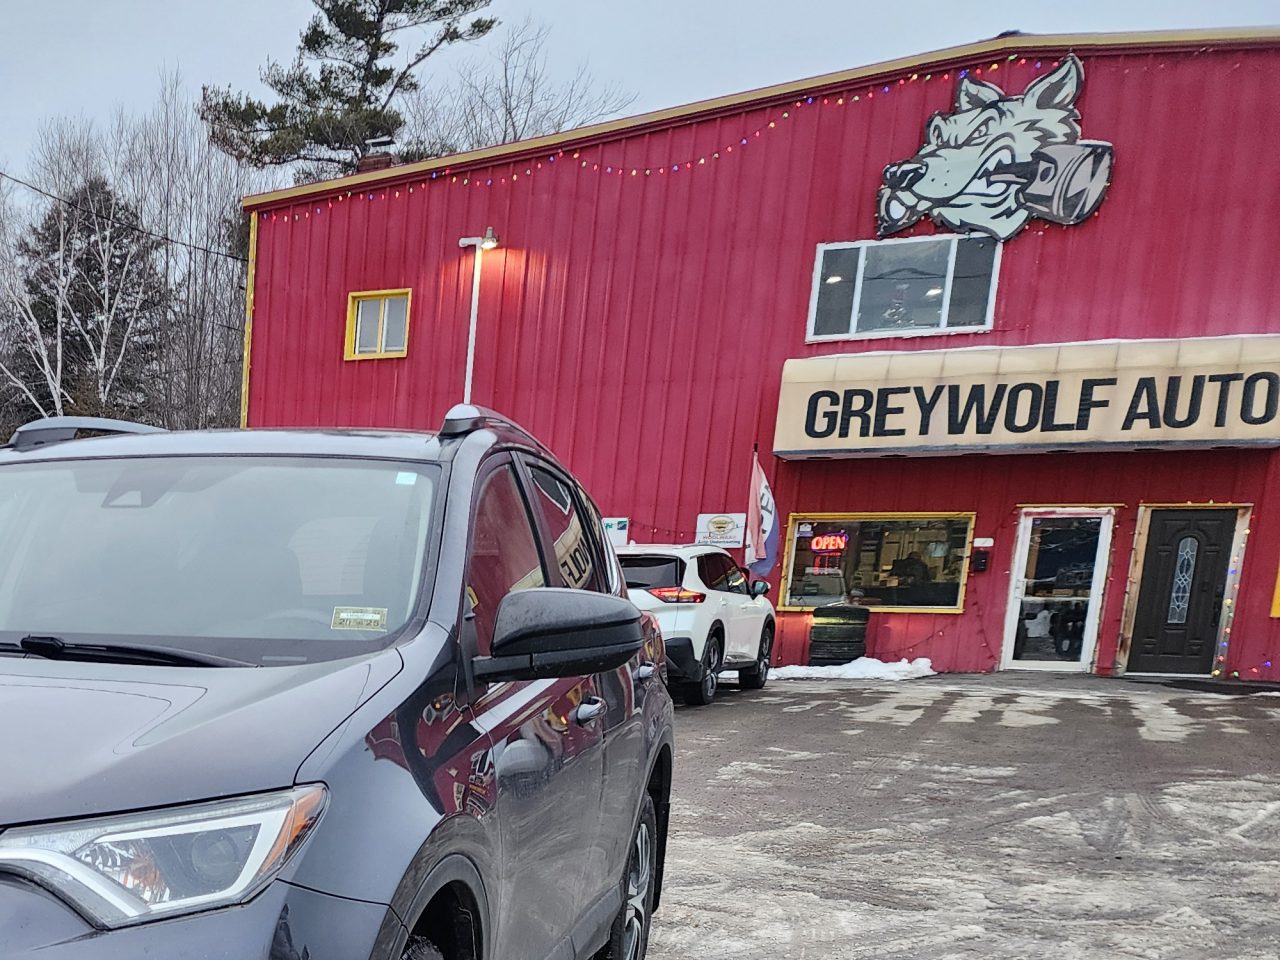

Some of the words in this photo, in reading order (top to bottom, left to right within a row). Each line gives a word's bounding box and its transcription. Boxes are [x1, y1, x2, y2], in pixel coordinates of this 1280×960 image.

[804, 377, 1118, 439] GREYWOLF
[1120, 371, 1279, 431] AUTO
[811, 536, 846, 550] OPEN
